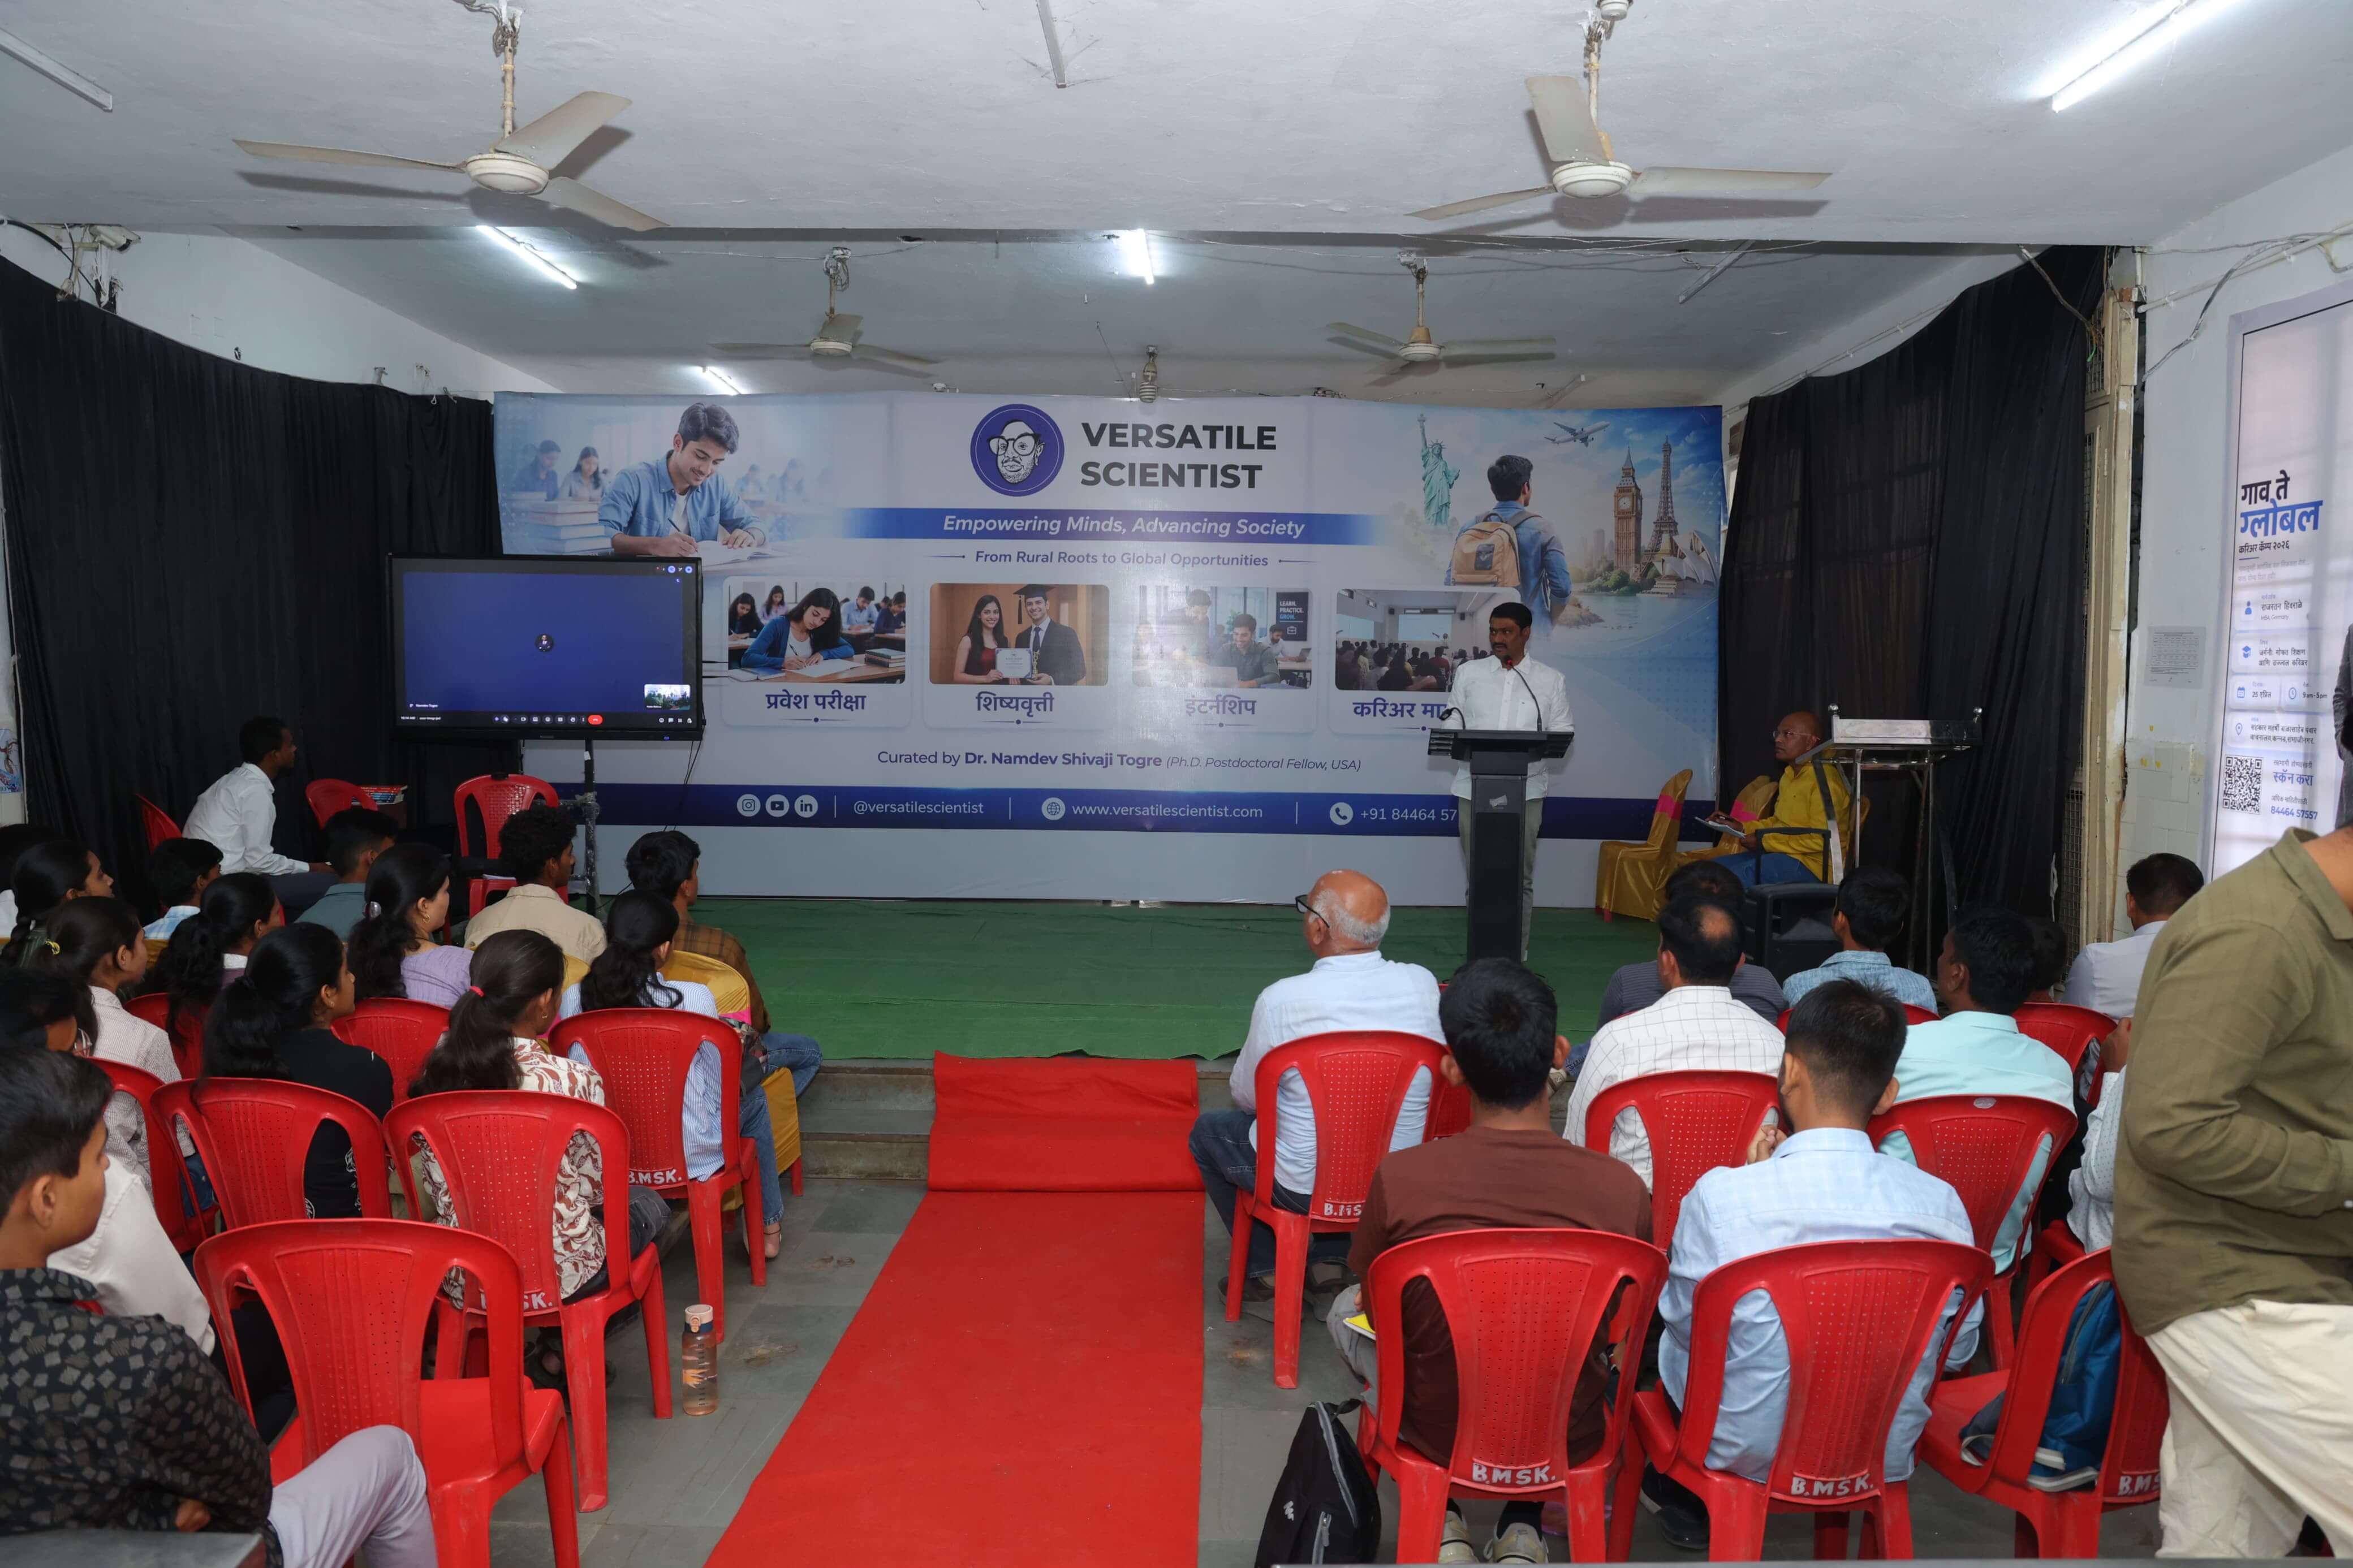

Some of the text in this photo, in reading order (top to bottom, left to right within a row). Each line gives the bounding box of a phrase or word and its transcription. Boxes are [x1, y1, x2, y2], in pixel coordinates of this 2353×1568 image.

[1081, 422, 1277, 450] VERSATILE
[1080, 461, 1262, 489] SCIENTIST
[2241, 469, 2290, 505] गाव ते
[943, 515, 1305, 539] Empowering Minds, Advancing Society
[2240, 498, 2324, 538] ग्लोबल
[2239, 543, 2258, 554] करिअर
[2273, 540, 2290, 550] २०२६
[975, 551, 1268, 567] From Rural Roots to Global Opportunities
[765, 689, 867, 711] प्रवेश परीक्षा
[975, 691, 1055, 717] शिष्यवृत्ती
[1184, 694, 1257, 716] इंटर्नशिप
[1352, 697, 1448, 718] करिअर मा
[877, 751, 1361, 772] Curated by Dr. Namdev Shivaji Togre (Ph.D. Postdoctoral Fellow, USA)
[2296, 774, 2315, 787] करा
[853, 800, 984, 815] @versatilescientist
[1072, 804, 1263, 818] www.versatilescientist.com
[1360, 808, 1458, 821] +91 84464 57
[2270, 806, 2318, 820] 84464 57557
[1472, 1462, 1556, 1485] B.MSK.
[1791, 1473, 1874, 1497] B.MSK.
